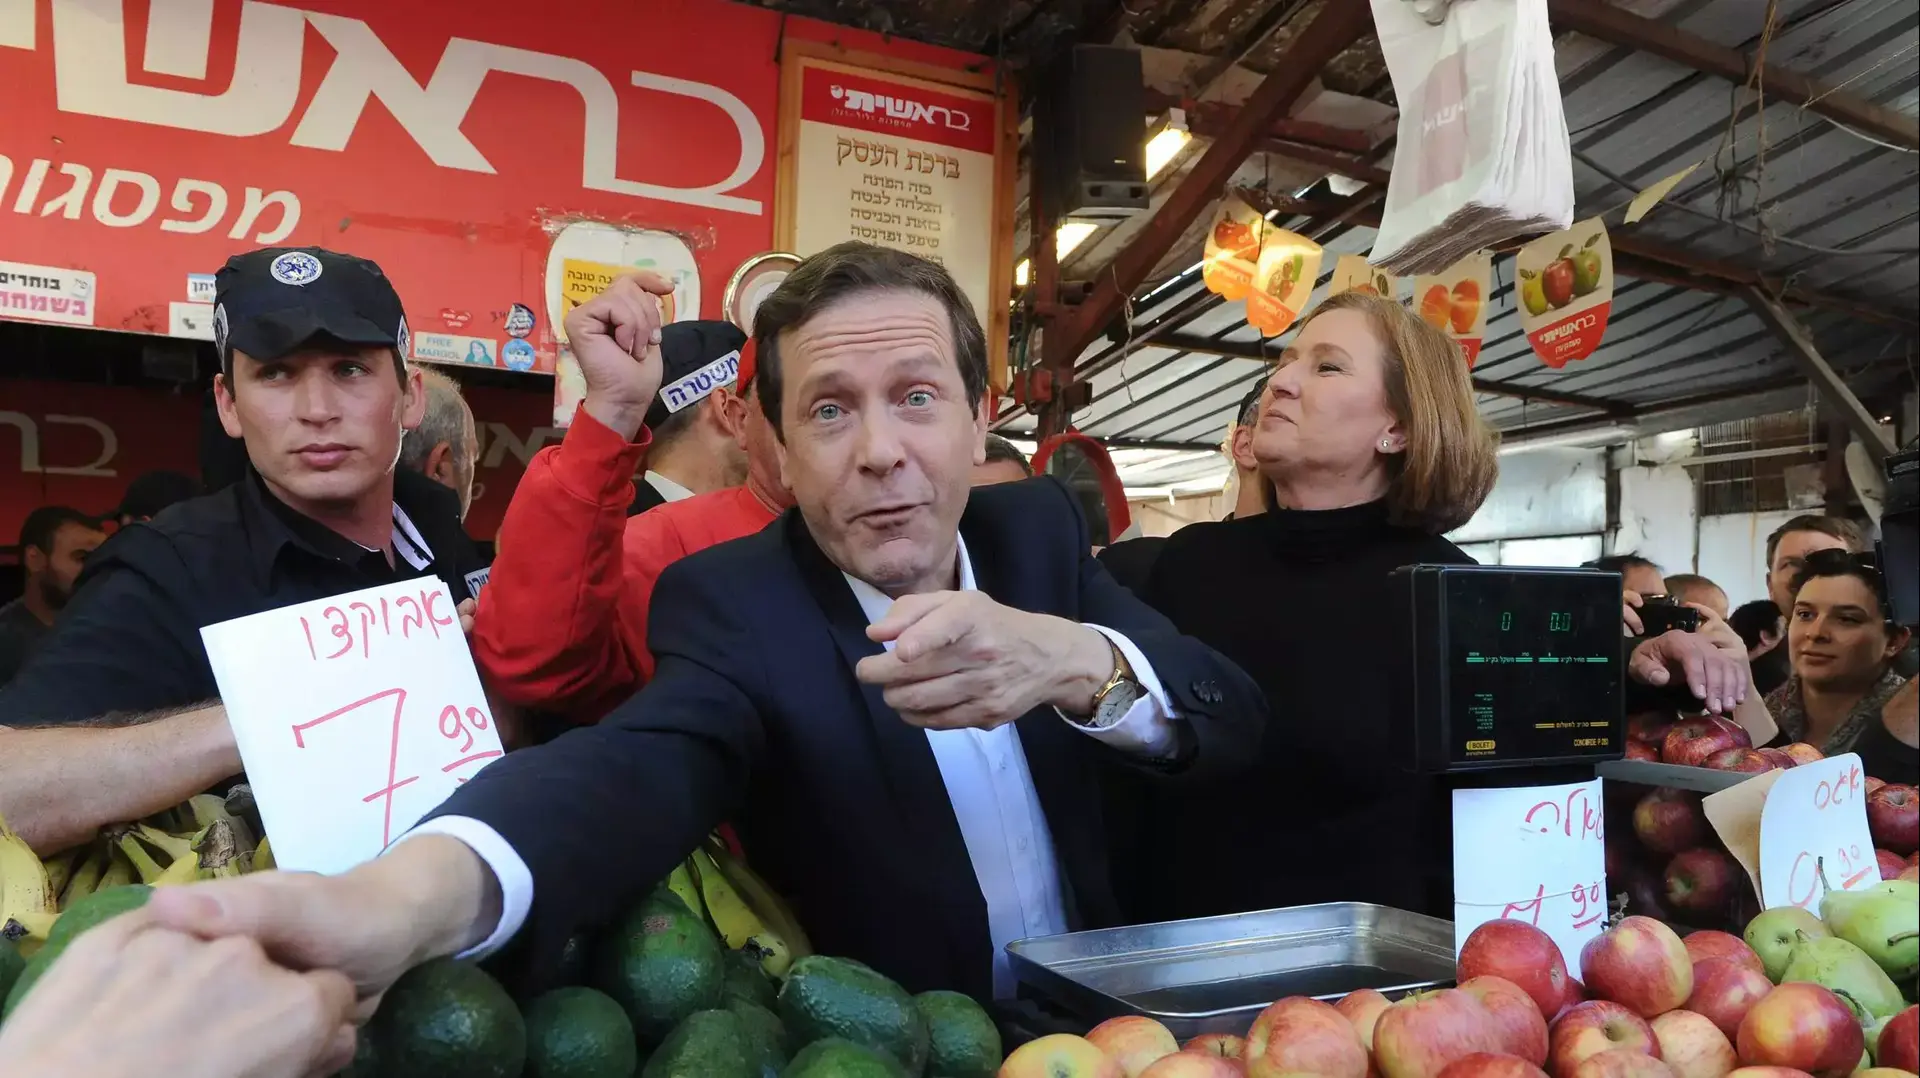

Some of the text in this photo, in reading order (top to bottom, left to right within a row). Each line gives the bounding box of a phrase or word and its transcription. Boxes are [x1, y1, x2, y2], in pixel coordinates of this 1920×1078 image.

[0, 0, 763, 215] בראש
[836, 134, 961, 179] ברכת העסק
[862, 173, 932, 195] בזה הפתח
[0, 153, 301, 245] מפסגו
[850, 189, 942, 214] הצלחה לבטח
[850, 207, 901, 225] הכניסה
[850, 224, 902, 242] ופרנסה
[567, 269, 613, 284] נה טובה
[426, 336, 453, 347] FREE
[667, 357, 739, 406] משטרה
[1501, 612, 1571, 631] 0 0.0
[292, 687, 488, 848] 7 90
[1571, 882, 1600, 919] 90
